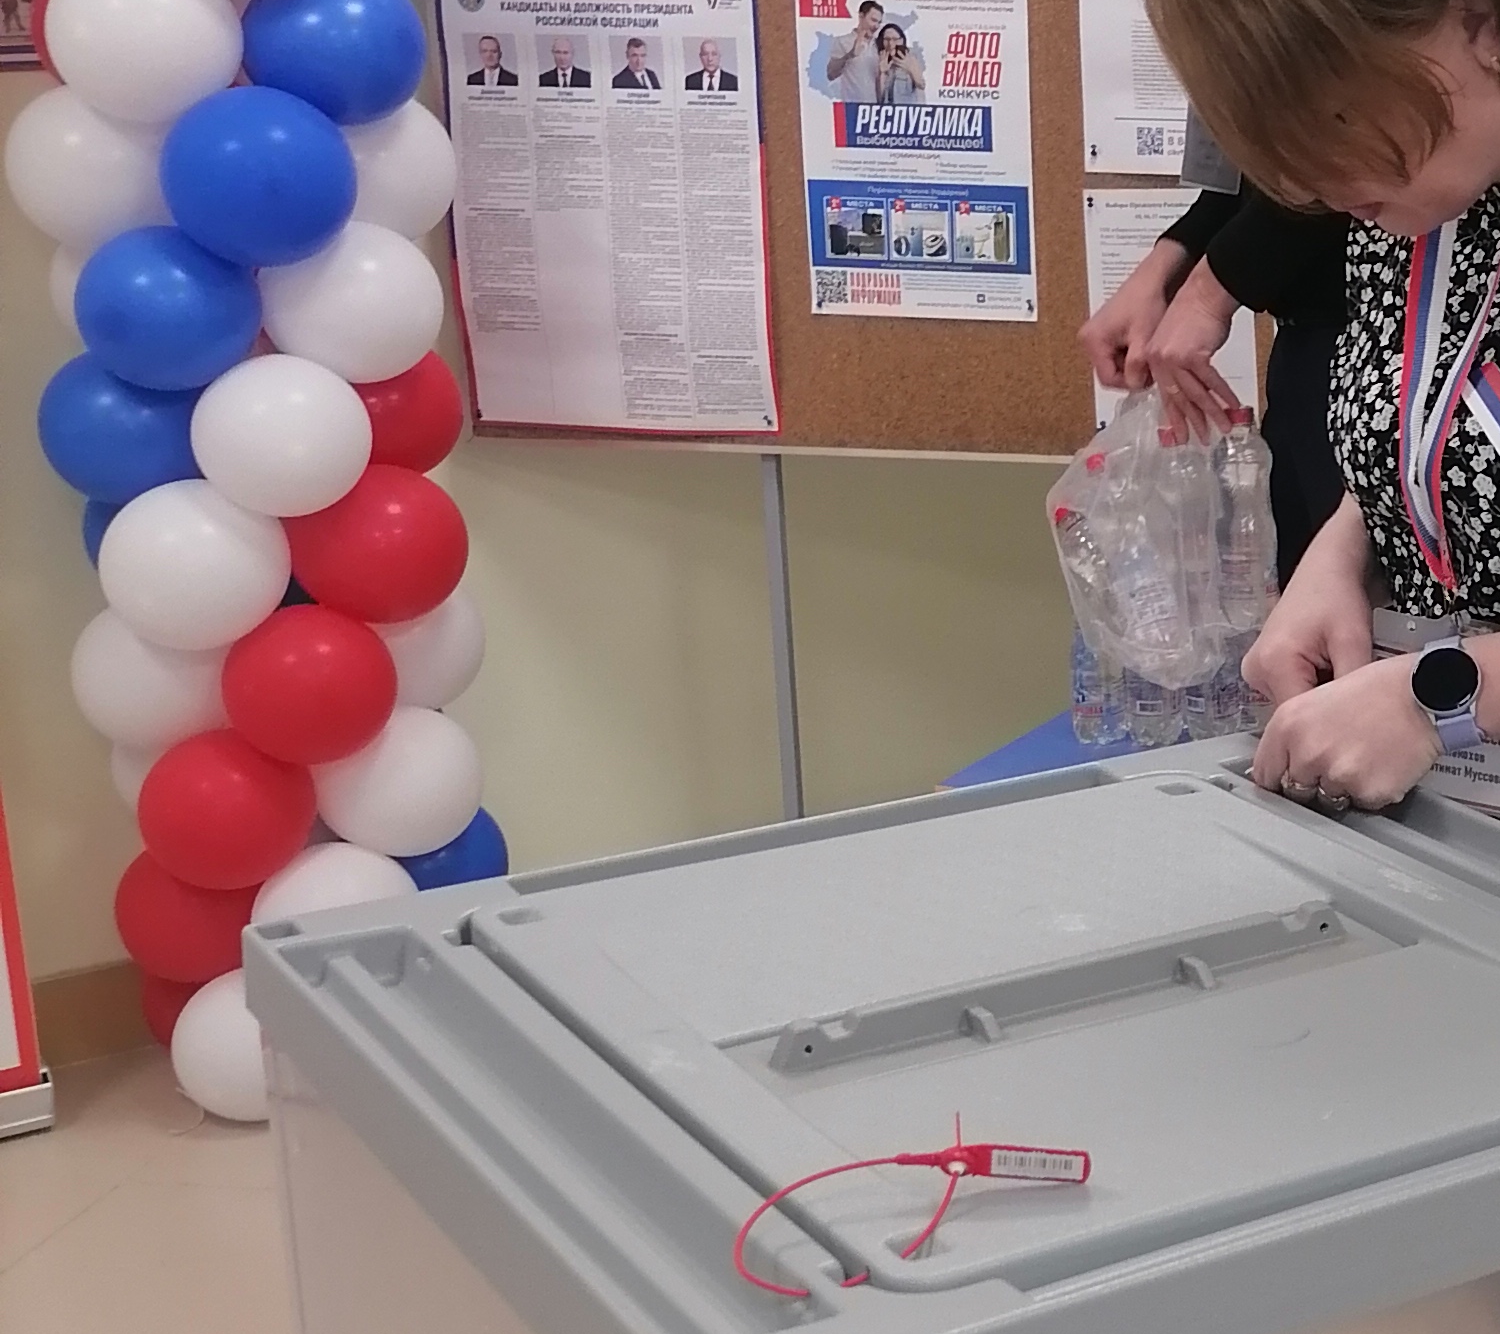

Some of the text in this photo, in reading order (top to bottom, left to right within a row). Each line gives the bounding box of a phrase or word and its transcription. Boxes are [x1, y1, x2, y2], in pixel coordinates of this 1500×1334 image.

[500, 1, 694, 16] КАНДИДАТЫ НА ДОЛЖНОСТЬ ПРЕЗИДЕНТА
[535, 14, 659, 29] РОССИЙСКОЙ ФЕДЕРАЦИИ
[947, 31, 1001, 59] ФОТО
[942, 60, 1002, 88] ВИДЕО
[938, 89, 1001, 100] КОНКУРС
[855, 104, 983, 137] РЕСПУБЛИКА
